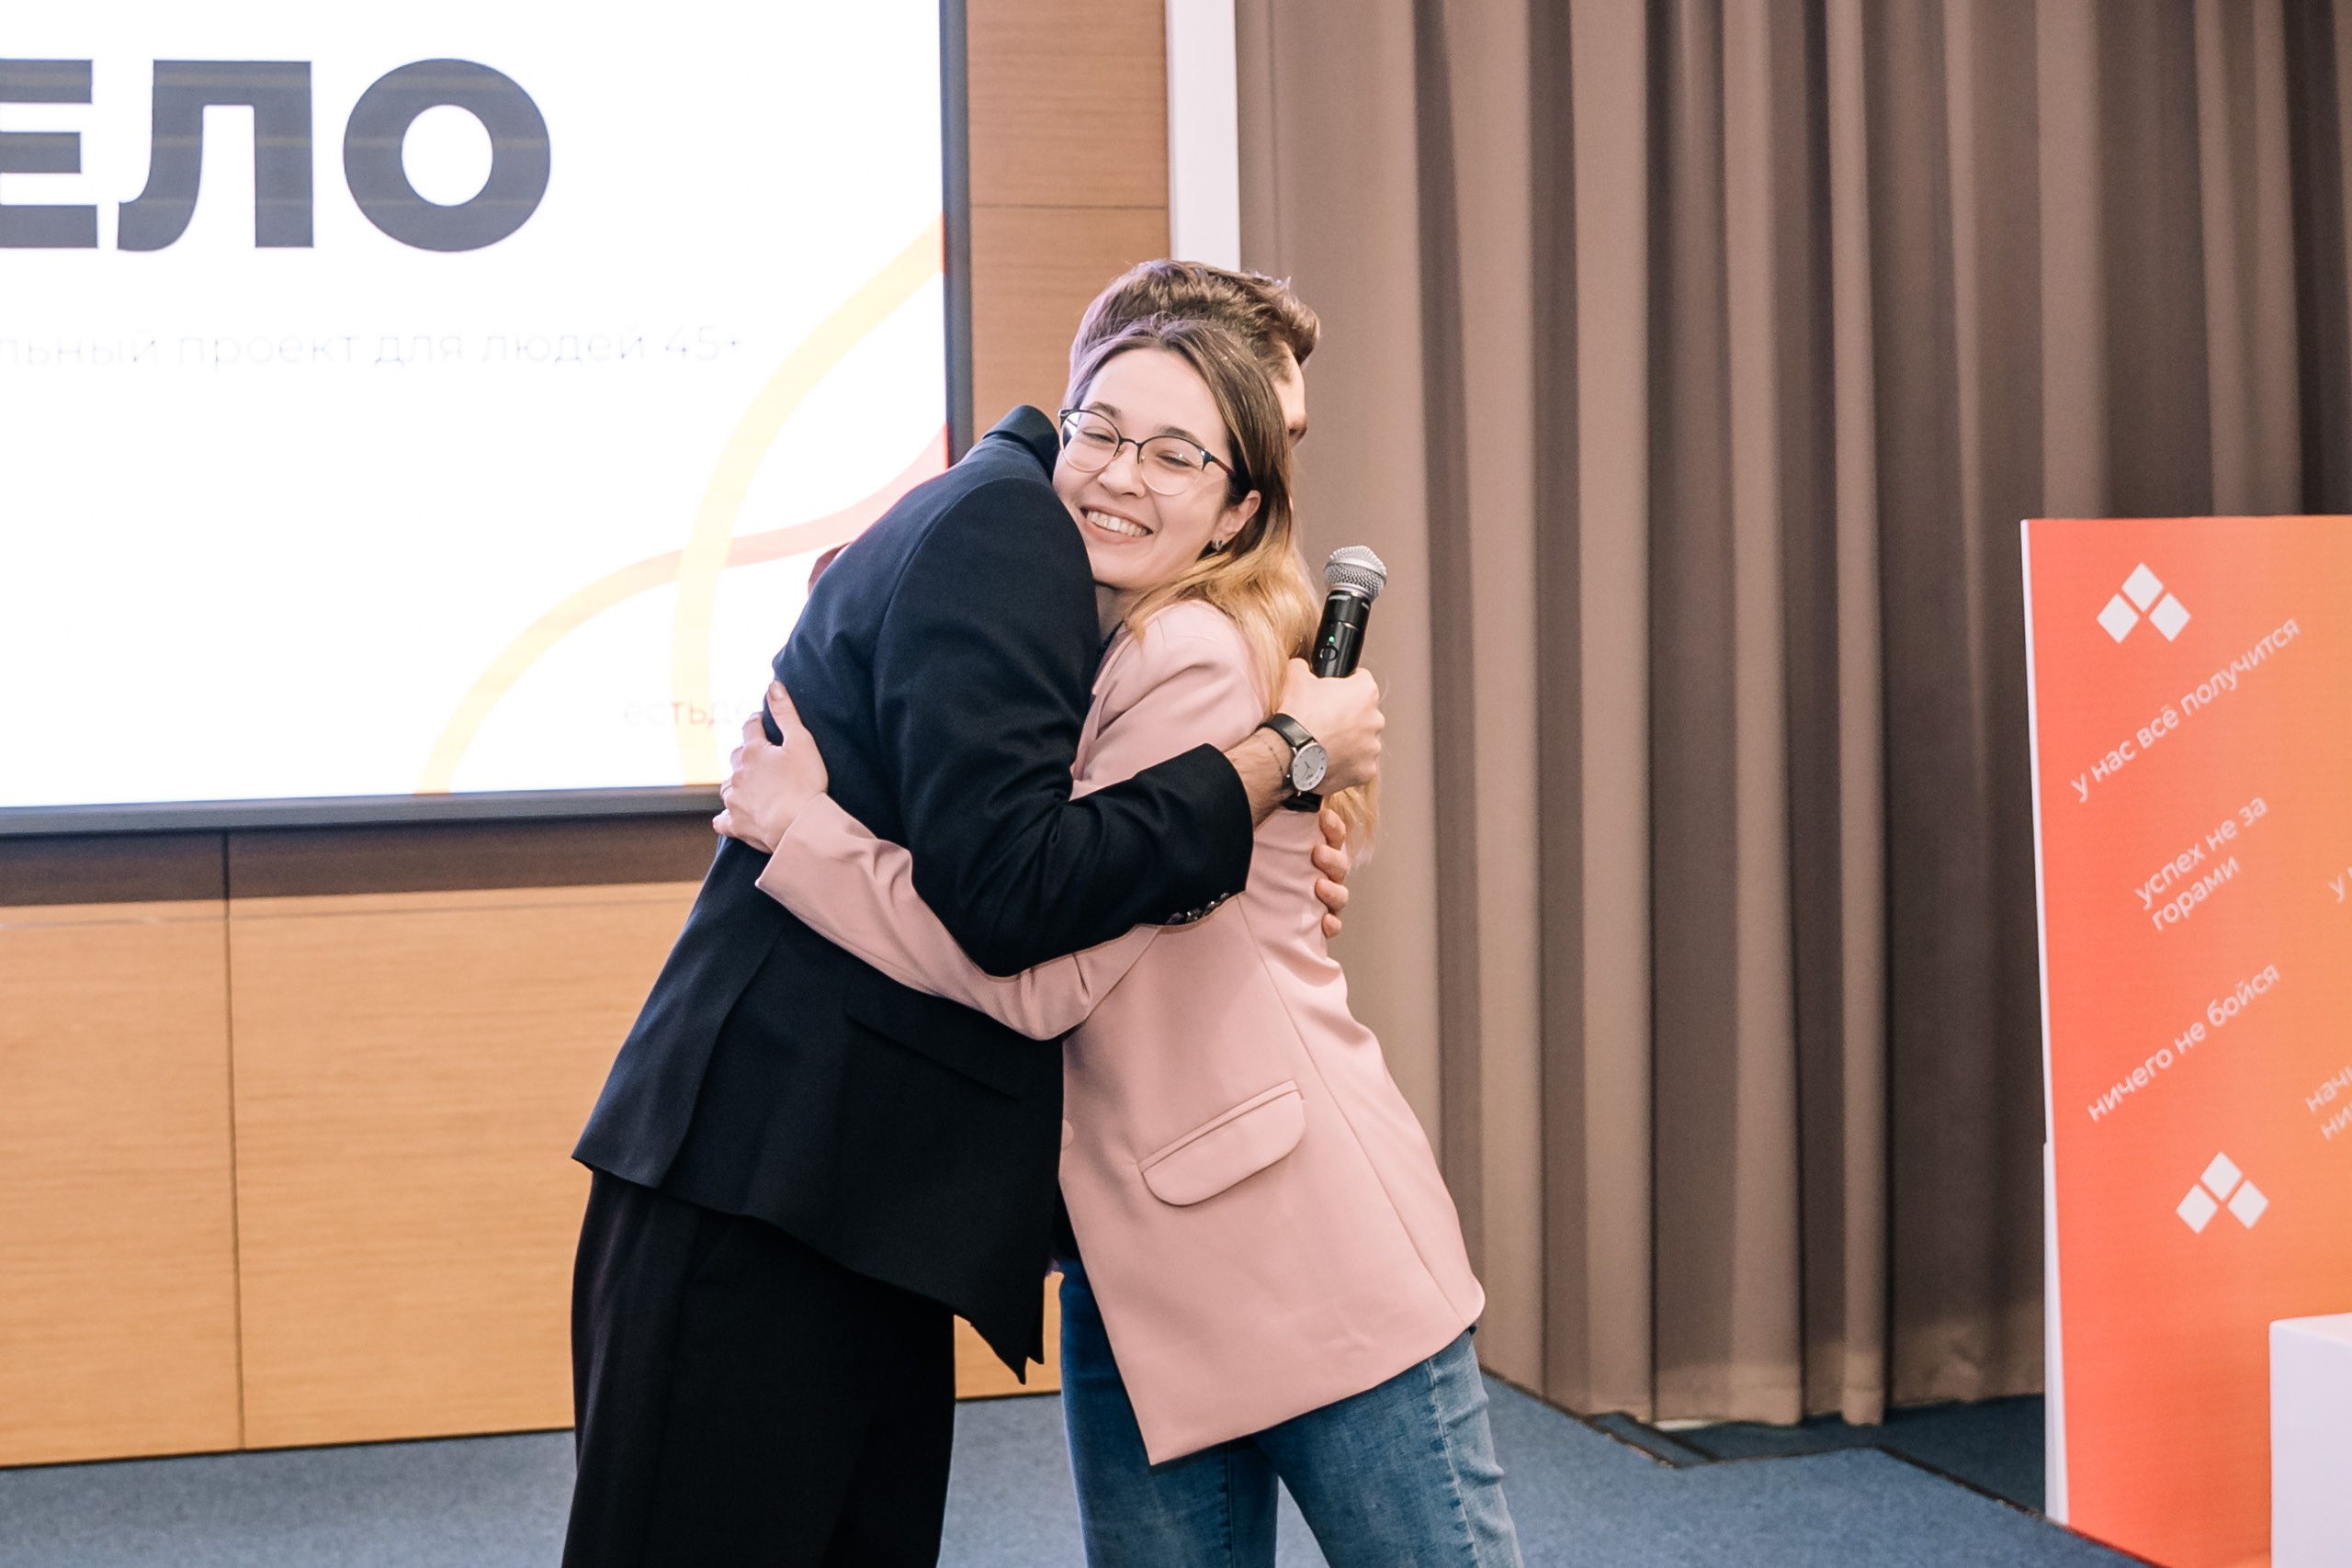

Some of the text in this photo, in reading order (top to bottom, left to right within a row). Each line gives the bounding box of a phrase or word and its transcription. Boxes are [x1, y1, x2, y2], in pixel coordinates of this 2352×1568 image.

[0, 57, 551, 253] ЕЛО
[178, 333, 359, 373] проект
[375, 333, 463, 369] для
[481, 324, 646, 369] людей
[663, 324, 744, 362] 45+
[2070, 618, 2301, 804] у нас всё получится
[2134, 796, 2268, 911] успех не за
[2151, 856, 2241, 932] горами
[2327, 874, 2346, 904] у
[2086, 964, 2281, 1122] ничего не бойся
[2320, 1101, 2352, 1141] ни
